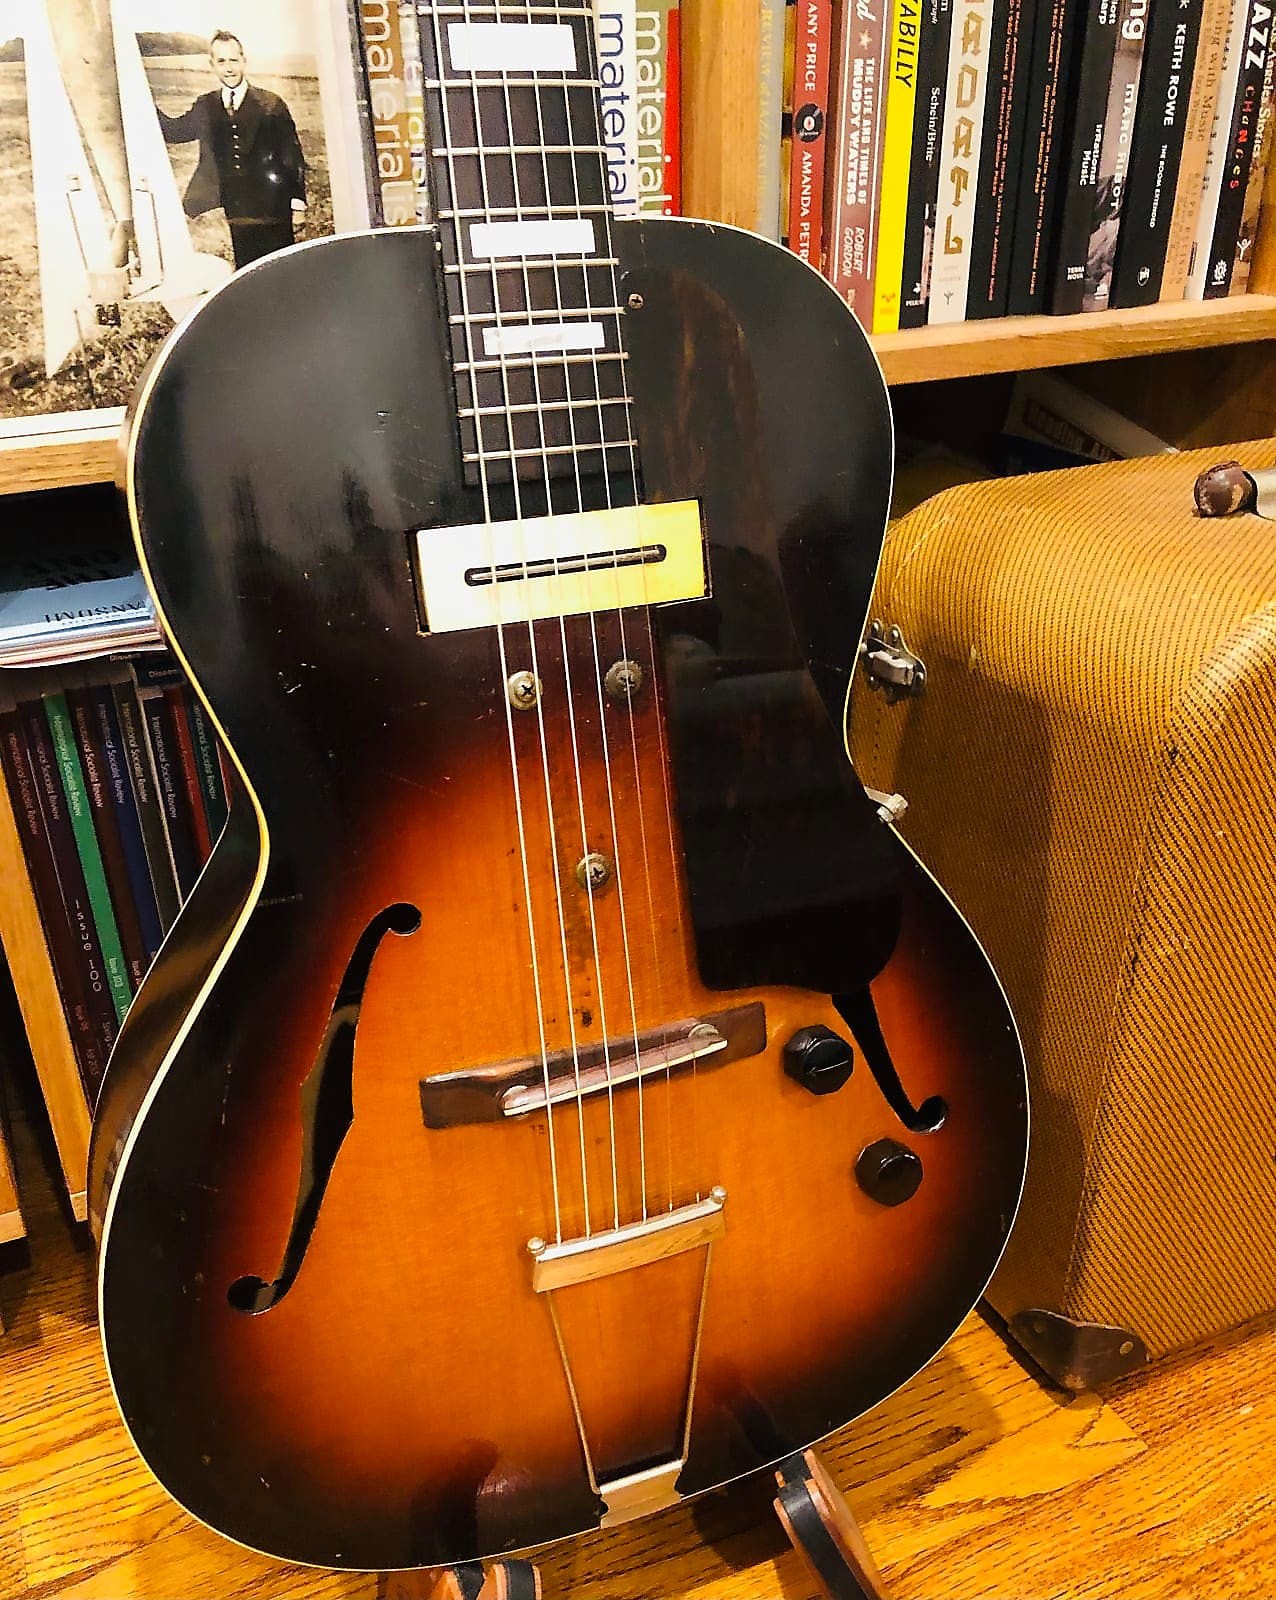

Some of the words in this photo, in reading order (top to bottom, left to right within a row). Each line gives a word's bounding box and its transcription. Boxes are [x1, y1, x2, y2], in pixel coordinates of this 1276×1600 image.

[807, 3, 818, 36] ANY
[805, 43, 817, 92] PRICE
[1171, 23, 1187, 70] KEITH
[864, 57, 875, 84] THE
[850, 58, 864, 128] MUDDY
[863, 87, 874, 114] LIFE
[1163, 75, 1180, 126] ROWE
[862, 119, 872, 143] AND
[1160, 144, 1168, 159] THE
[1252, 106, 1271, 158] Stories
[800, 151, 813, 217] AMANDA
[846, 131, 861, 206] WATERS
[859, 148, 870, 187] TIMES
[1080, 150, 1092, 186] Music
[1110, 152, 1127, 210] RIBOT
[857, 190, 867, 205] OF
[1149, 188, 1161, 228] EXTENDED
[843, 227, 854, 277] GORDON
[854, 227, 865, 274] ROBERT
[89, 959, 102, 992] 100
